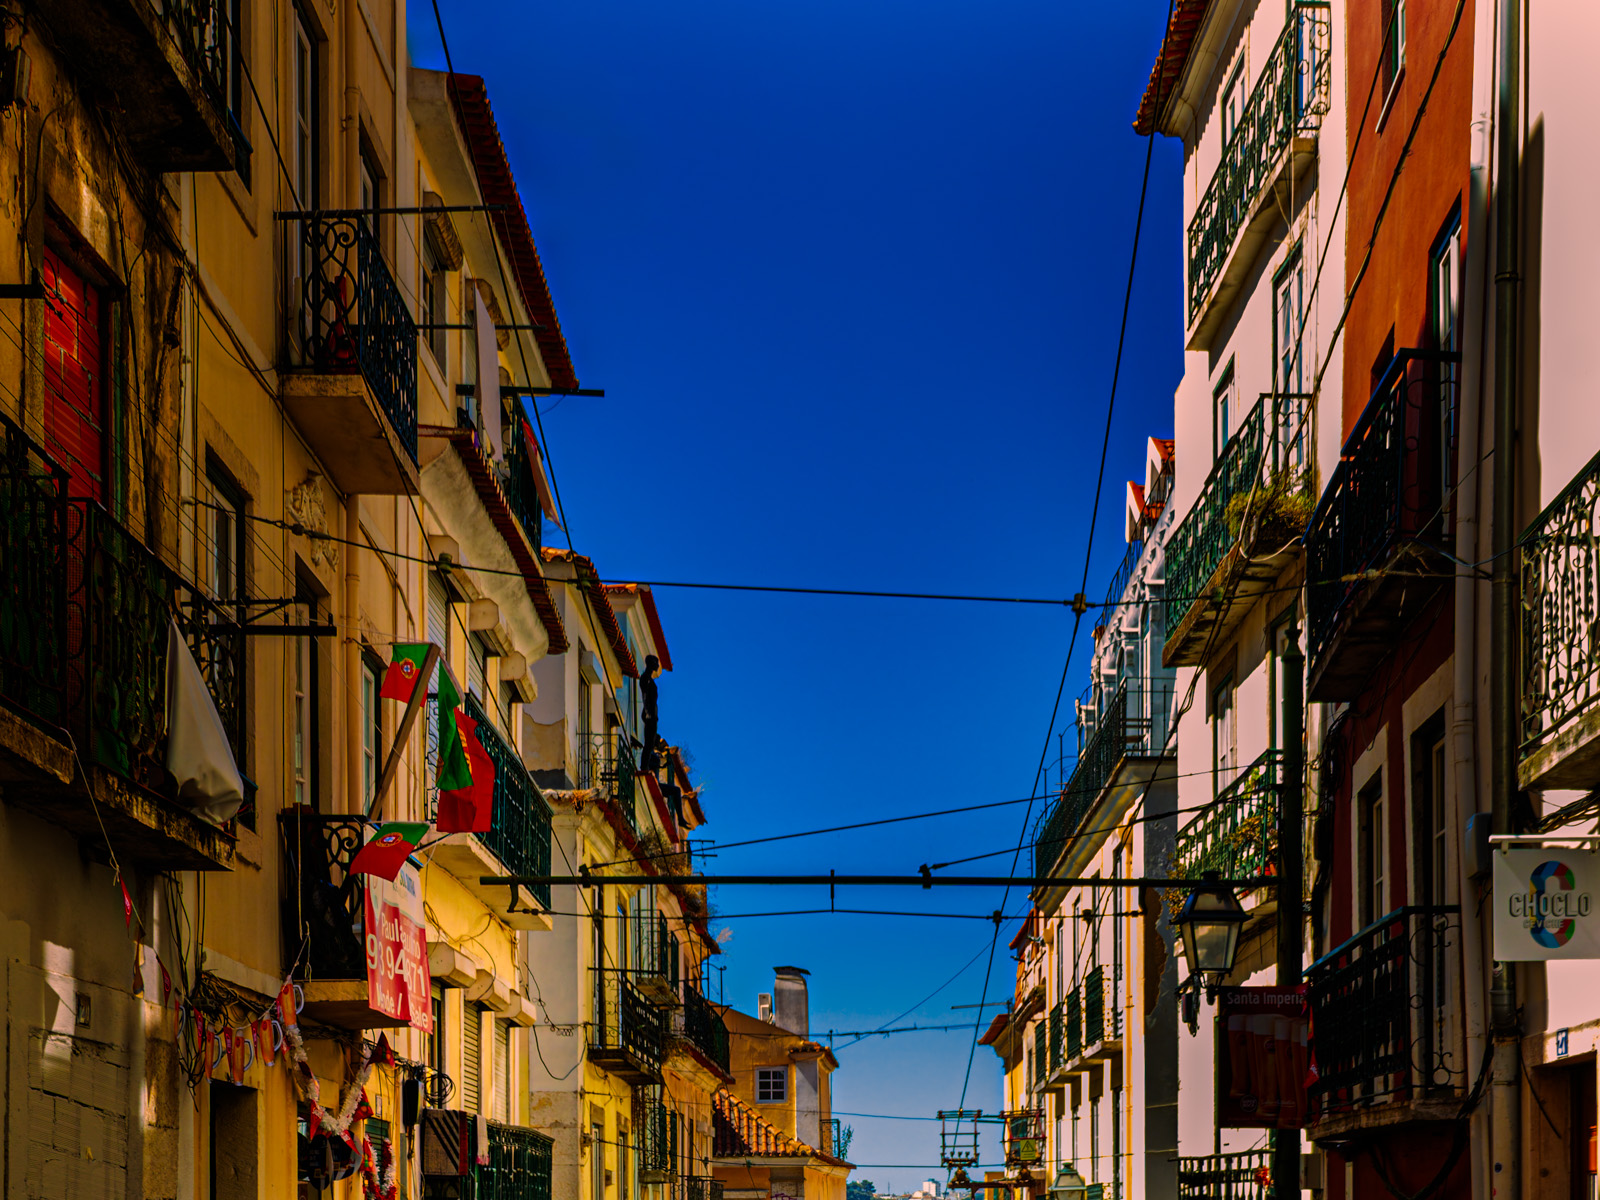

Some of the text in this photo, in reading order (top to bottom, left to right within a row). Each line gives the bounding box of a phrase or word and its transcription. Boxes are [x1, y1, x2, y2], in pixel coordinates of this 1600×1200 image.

[1509, 892, 1592, 918] CHOCLO
[1523, 919, 1565, 929] CEVICHE
[1226, 992, 1261, 1005] Santa
